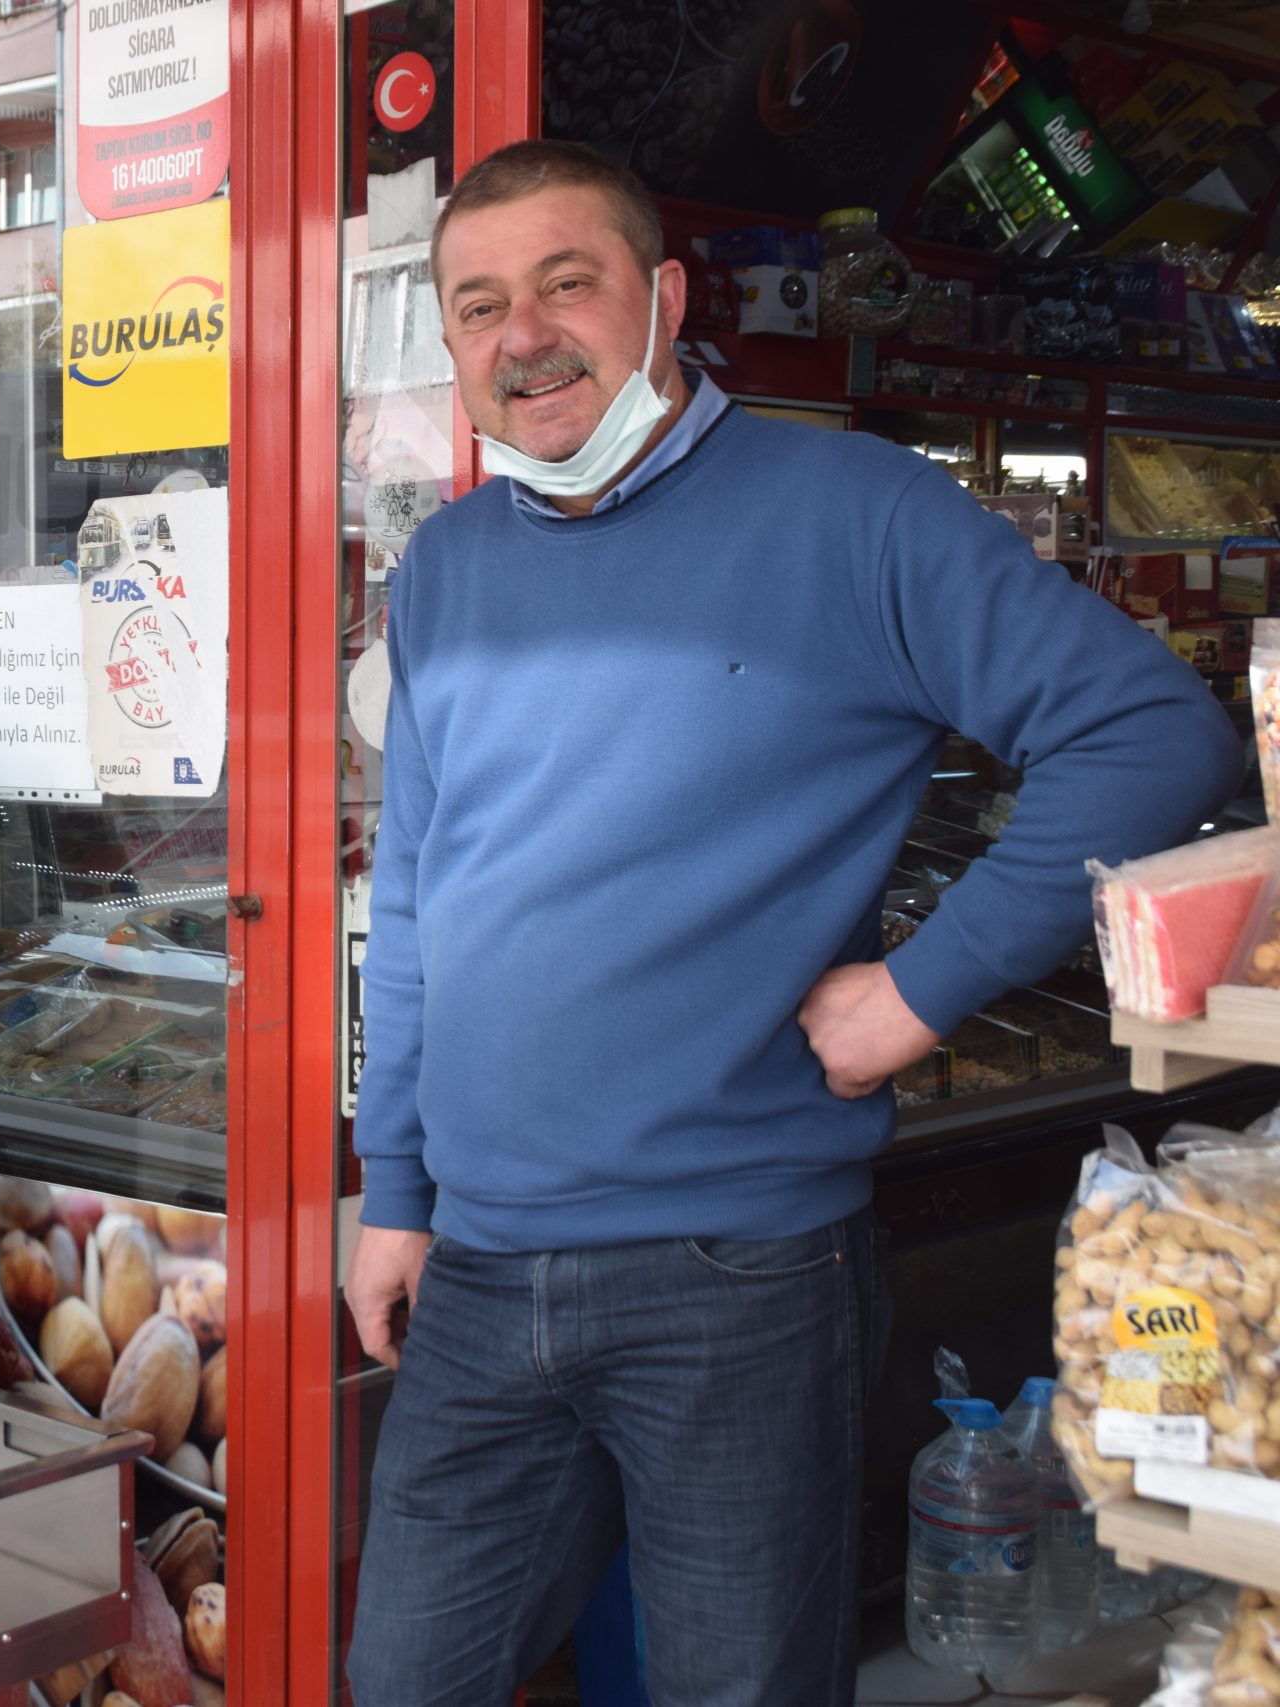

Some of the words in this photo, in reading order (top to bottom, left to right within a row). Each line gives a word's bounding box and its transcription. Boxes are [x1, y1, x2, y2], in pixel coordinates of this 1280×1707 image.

[129, 25, 175, 58] SİGARA
[108, 58, 189, 99] SATMIYORUZ
[69, 303, 225, 361] BURULAŞ
[50, 644, 80, 671] İçin
[4, 686, 20, 705] ile
[25, 685, 64, 709] Değil
[33, 725, 81, 743] Alınız.
[99, 764, 142, 778] BURULAŞ
[1126, 1304, 1200, 1337] SARI
